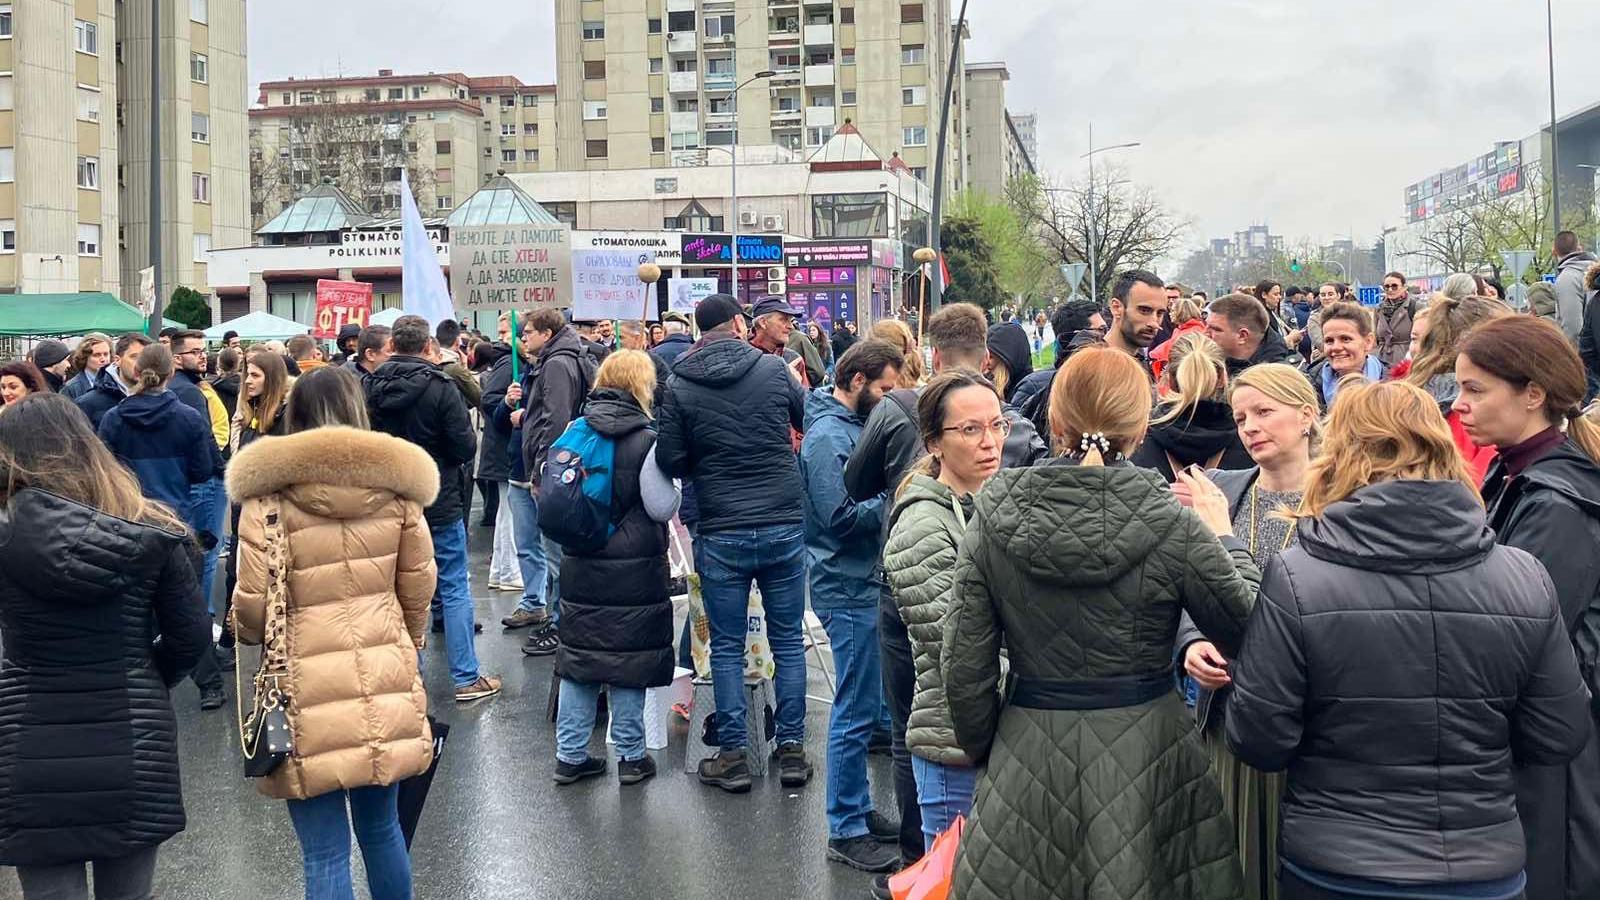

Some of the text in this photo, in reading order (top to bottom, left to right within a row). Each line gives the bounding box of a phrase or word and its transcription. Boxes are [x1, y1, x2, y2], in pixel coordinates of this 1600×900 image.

[344, 231, 439, 242] STOMATOA
[455, 228, 564, 246] НЕМОЈТЕ ДА ПАМТИТЕ
[592, 238, 667, 246] СТОМАТОЛОШКА
[329, 246, 402, 257] POLIKLINIK
[472, 248, 549, 266] ДА СТЕ ХТЕЛИ
[720, 245, 781, 260] AUNNO
[466, 267, 558, 285] А ДА ЗАБОРАВИТЕ
[468, 287, 556, 305] ДА НИСТЕ СМЕЛИ
[320, 304, 365, 335] ФТН
